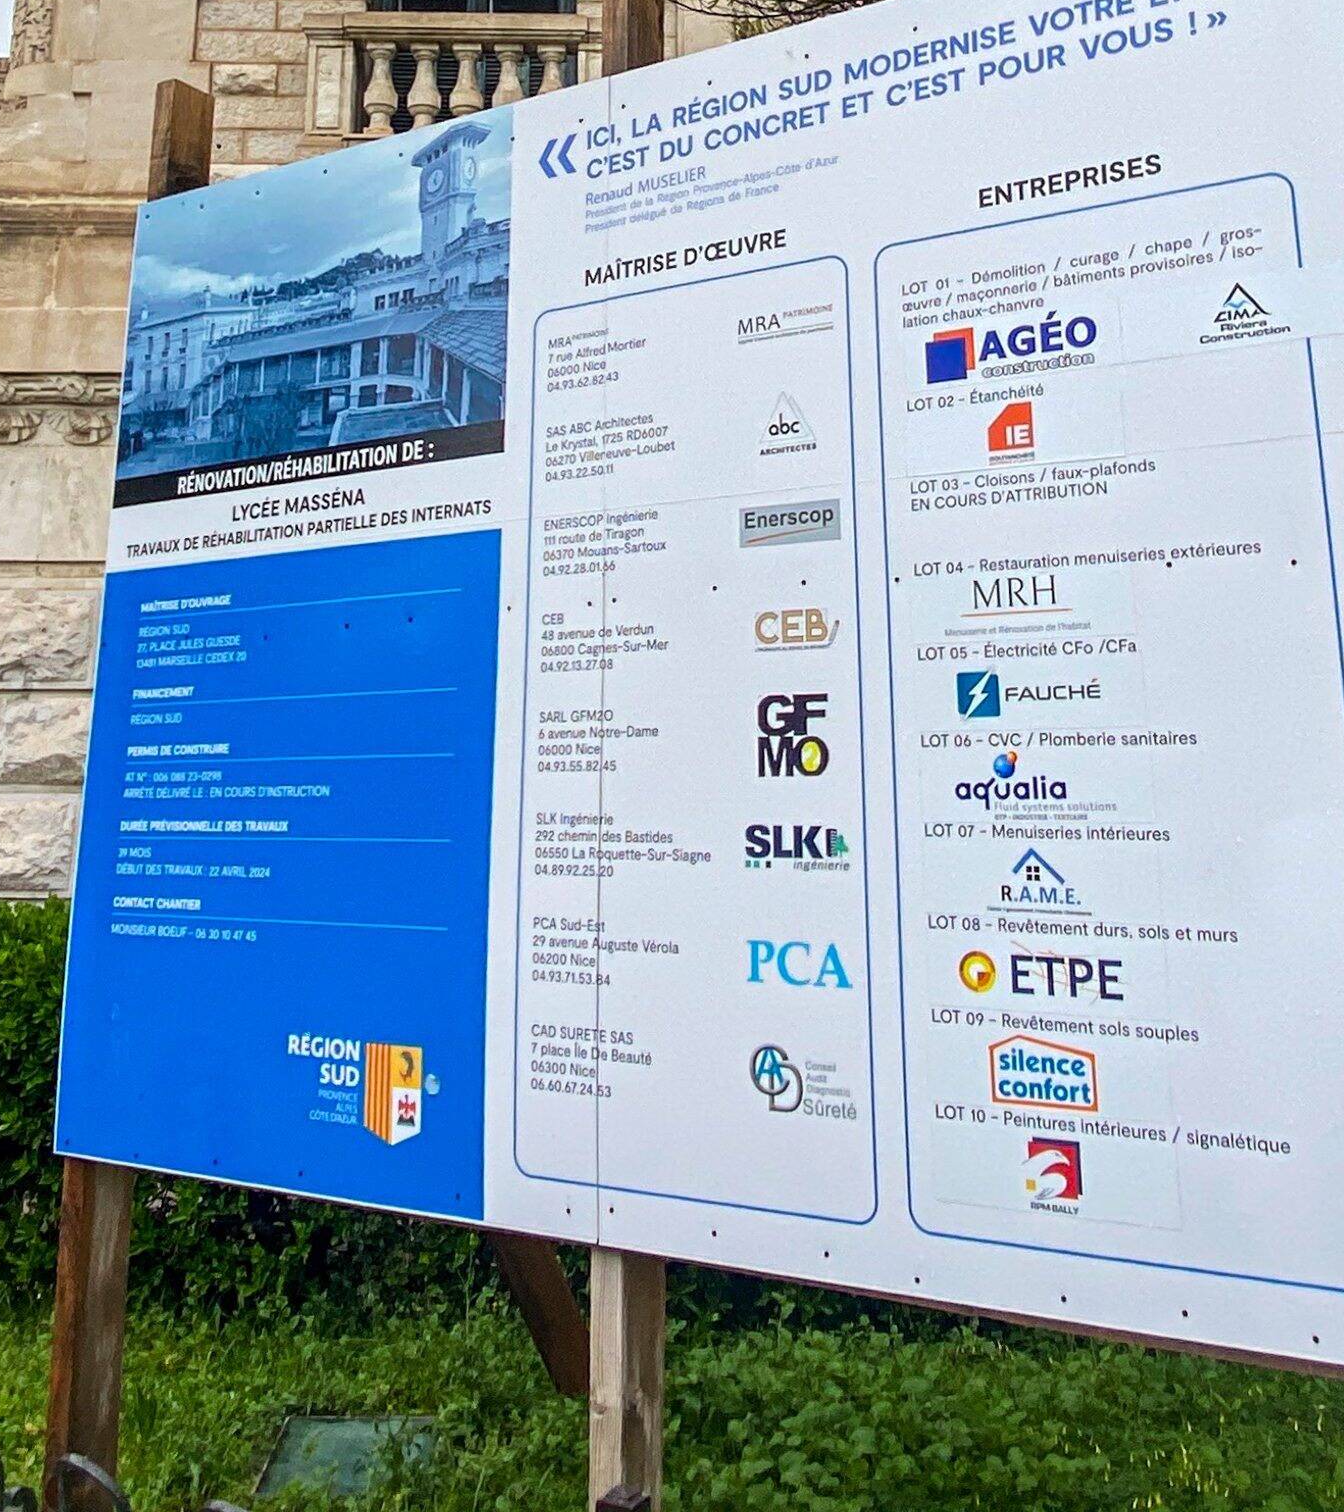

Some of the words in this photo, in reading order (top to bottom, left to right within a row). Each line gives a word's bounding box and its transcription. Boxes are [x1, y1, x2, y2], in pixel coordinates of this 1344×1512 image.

[586, 124, 622, 150] ICI,
[632, 114, 662, 138] LA
[673, 84, 768, 128] RÉGION
[778, 69, 832, 101] SUD
[844, 20, 1016, 84] MODERNISE
[660, 135, 694, 162] DU
[704, 102, 831, 151] CONCRET
[842, 90, 874, 118] ET
[978, 44, 1067, 86] POUR
[1079, 18, 1174, 60] VOUS
[586, 186, 633, 205] Renaud
[638, 166, 706, 194] MUSELIER
[978, 154, 1162, 208] ENTREPRISES
[584, 251, 677, 286] MAÎTRISE
[901, 280, 929, 296] LOT
[936, 277, 951, 292] 01
[971, 261, 1046, 286] Démolition
[1070, 250, 1120, 269] curage
[1145, 236, 1193, 257] chape
[1219, 227, 1262, 245] gros-
[901, 296, 942, 313] œuvre
[956, 280, 1038, 305] maçonnerie
[1053, 266, 1126, 288] bâtiments
[1129, 251, 1214, 277] provisoires
[1231, 244, 1263, 260] iso-
[738, 313, 781, 335] MRA
[903, 313, 939, 328] lation
[942, 297, 1045, 323] chaux-chanvre
[978, 311, 1097, 361] AGÉO
[1199, 325, 1291, 344] Construction
[980, 352, 1096, 379] construction
[906, 397, 933, 412] LOT
[937, 394, 955, 408] 02
[969, 383, 1045, 405] Étanchéité
[547, 425, 566, 438] SAS
[570, 422, 592, 434] ABC
[596, 414, 653, 431] Architectes
[768, 413, 801, 436] abc
[1004, 425, 1030, 447] IE
[759, 442, 817, 456] ARCHITECTES
[177, 444, 397, 495] RÉNOVATION/RÉHABILITATION
[401, 440, 424, 461] DE
[910, 480, 939, 495] LOT
[942, 478, 960, 492] 03
[974, 469, 1035, 489] Cloisons
[1051, 458, 1157, 483] faux-plafonds
[231, 496, 281, 522] LYCÉE
[284, 487, 366, 515] MASSÉNA
[911, 497, 931, 512] EN
[933, 492, 987, 509] COURS
[991, 481, 1108, 504] D'ATTRIBUTION
[126, 538, 181, 558] TRAVAUX
[183, 535, 199, 550] DE
[202, 523, 304, 549] RÉHABILITATION
[307, 512, 377, 536] PARTIELLE
[381, 509, 408, 526] DES
[411, 499, 492, 522] INTERNATS
[744, 507, 834, 530] Enerscop
[913, 561, 940, 577] LOT
[943, 560, 964, 573] 04
[979, 551, 1070, 573] Restauration
[1074, 547, 1166, 566] menuiseries
[1170, 539, 1262, 560] extérieures
[972, 574, 1057, 610] MRH
[542, 613, 564, 625] CEB
[754, 608, 828, 645] CEB
[917, 646, 945, 660] LOT
[948, 646, 967, 659] 05
[984, 641, 1057, 658] Électricité
[1062, 640, 1094, 656] CFo
[1003, 677, 1102, 702] FAUCHÉ
[540, 711, 567, 723] SARL
[160, 745, 172, 756] DE
[920, 734, 950, 748] LOT
[954, 734, 972, 747] 06
[988, 732, 1022, 747] CVC
[1038, 732, 1116, 747] Plomberie
[1120, 731, 1198, 746] sanitaires
[954, 776, 1068, 811] aqualia
[224, 821, 243, 832] DES
[536, 812, 556, 825] SLK
[924, 823, 953, 837] LOT
[957, 825, 975, 838] 07
[991, 825, 1082, 841] Menuiseries
[1086, 825, 1170, 842] intérieures
[793, 860, 850, 872] ingénierie
[113, 896, 155, 909] CONTACT
[1000, 885, 1082, 906] R.A.M.E.
[533, 916, 556, 930] PCA
[927, 914, 958, 931] LOT
[962, 917, 981, 931] 08
[997, 917, 1089, 937] Revêtement
[1138, 925, 1170, 940] sols
[1175, 928, 1192, 940] et
[1197, 928, 1239, 943] murs
[532, 952, 566, 965] 06200
[570, 954, 596, 967] Nice
[746, 939, 853, 989] PCA
[1010, 953, 1124, 1001] ETPE
[531, 1024, 556, 1038] CAD
[610, 1030, 634, 1045] SAS
[931, 1008, 961, 1025] LOT
[965, 1012, 985, 1026] 09
[1001, 1013, 1094, 1036] Revêtement
[1099, 1021, 1131, 1036] sols
[1135, 1024, 1200, 1044] souples
[287, 1032, 361, 1062] RÉGION
[319, 1063, 360, 1087] SUD
[998, 1048, 1086, 1078] silence
[998, 1077, 1092, 1105] confort
[803, 1099, 857, 1120] Sûreté
[935, 1103, 965, 1121] LOT
[970, 1107, 987, 1123] 10
[1003, 1111, 1076, 1134] Peintures
[1080, 1121, 1167, 1143] intérieures
[1187, 1129, 1291, 1156] signalétique
